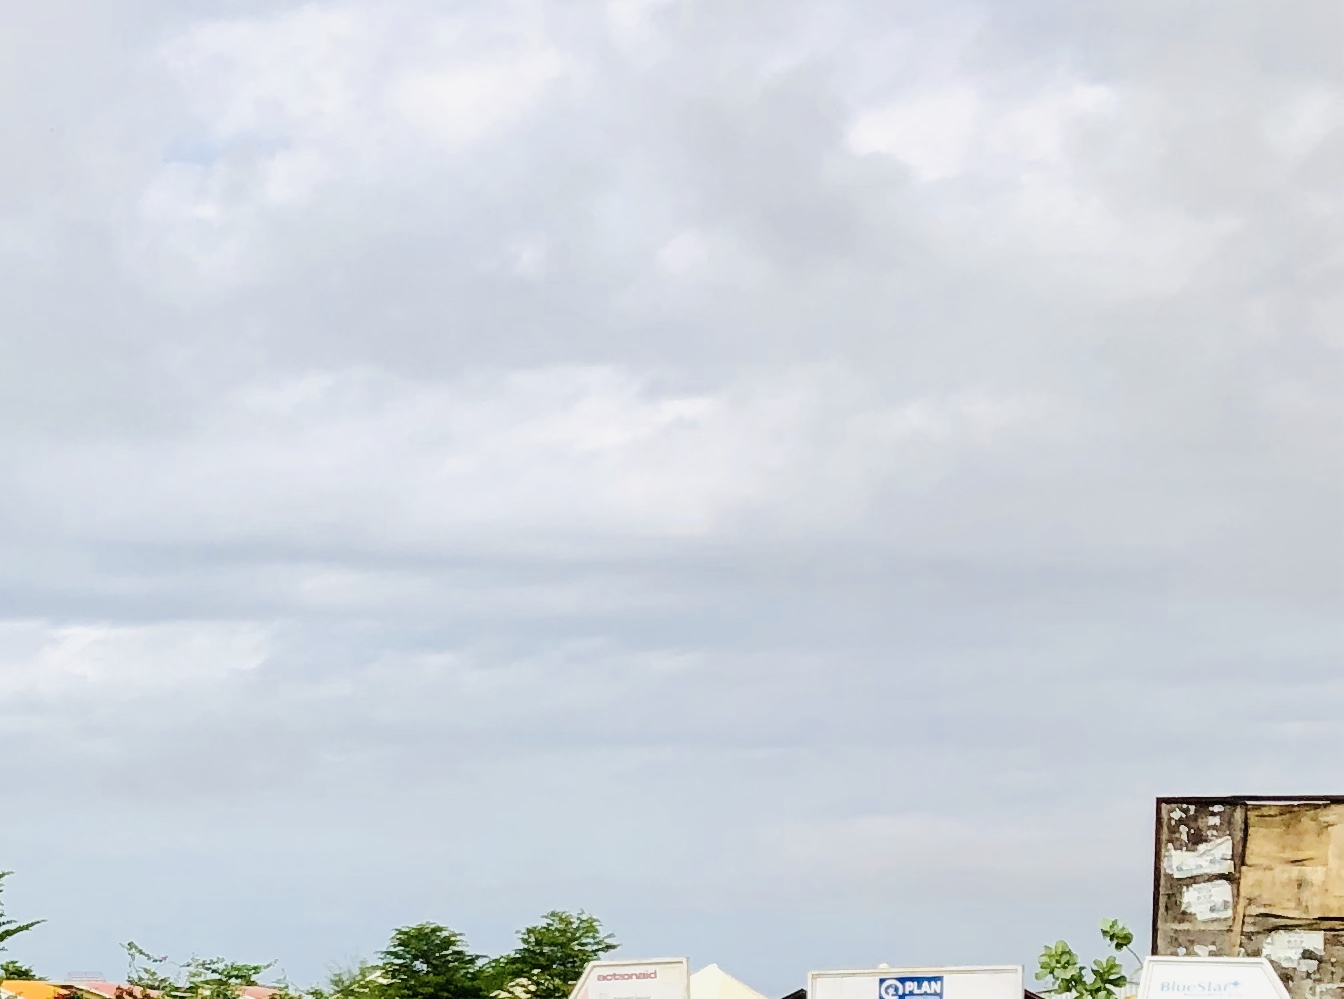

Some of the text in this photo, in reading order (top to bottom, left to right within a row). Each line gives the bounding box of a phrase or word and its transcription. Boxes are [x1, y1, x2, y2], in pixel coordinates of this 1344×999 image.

[597, 970, 657, 981] actionaid
[904, 980, 941, 994] PLAN
[1160, 980, 1229, 992] BlueStar
